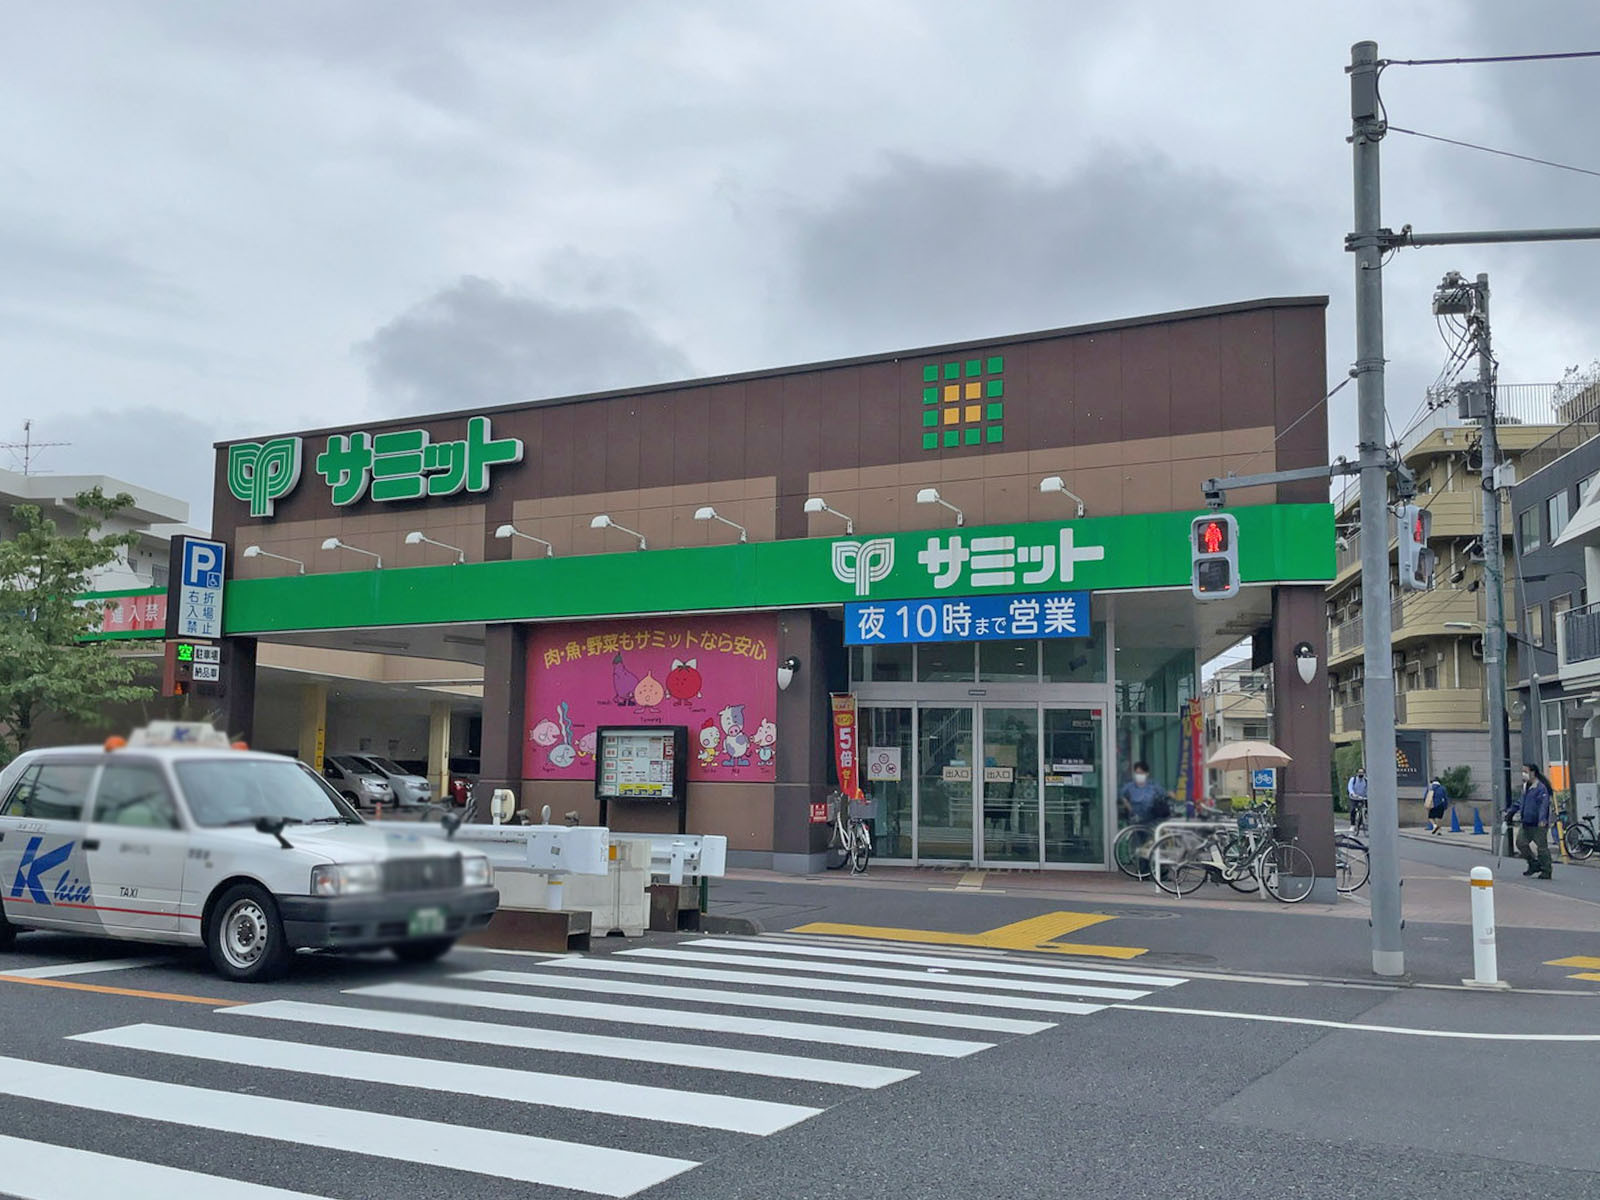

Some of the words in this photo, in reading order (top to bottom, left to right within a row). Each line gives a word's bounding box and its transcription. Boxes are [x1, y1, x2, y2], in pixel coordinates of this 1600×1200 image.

[316, 416, 524, 506] サミット
[190, 545, 216, 583] P
[918, 528, 1105, 589] サミット
[188, 591, 215, 605] 右折
[111, 603, 167, 624] 進入禁
[187, 605, 214, 620] 入場
[858, 597, 1076, 640] 夜10時まで営業
[186, 620, 212, 635] 禁止
[543, 630, 768, 669] 肉・魚・野菜もサミットなら安心
[945, 769, 969, 778] 出入口
[986, 769, 1011, 779] 出入口
[119, 886, 139, 898] TAXI
